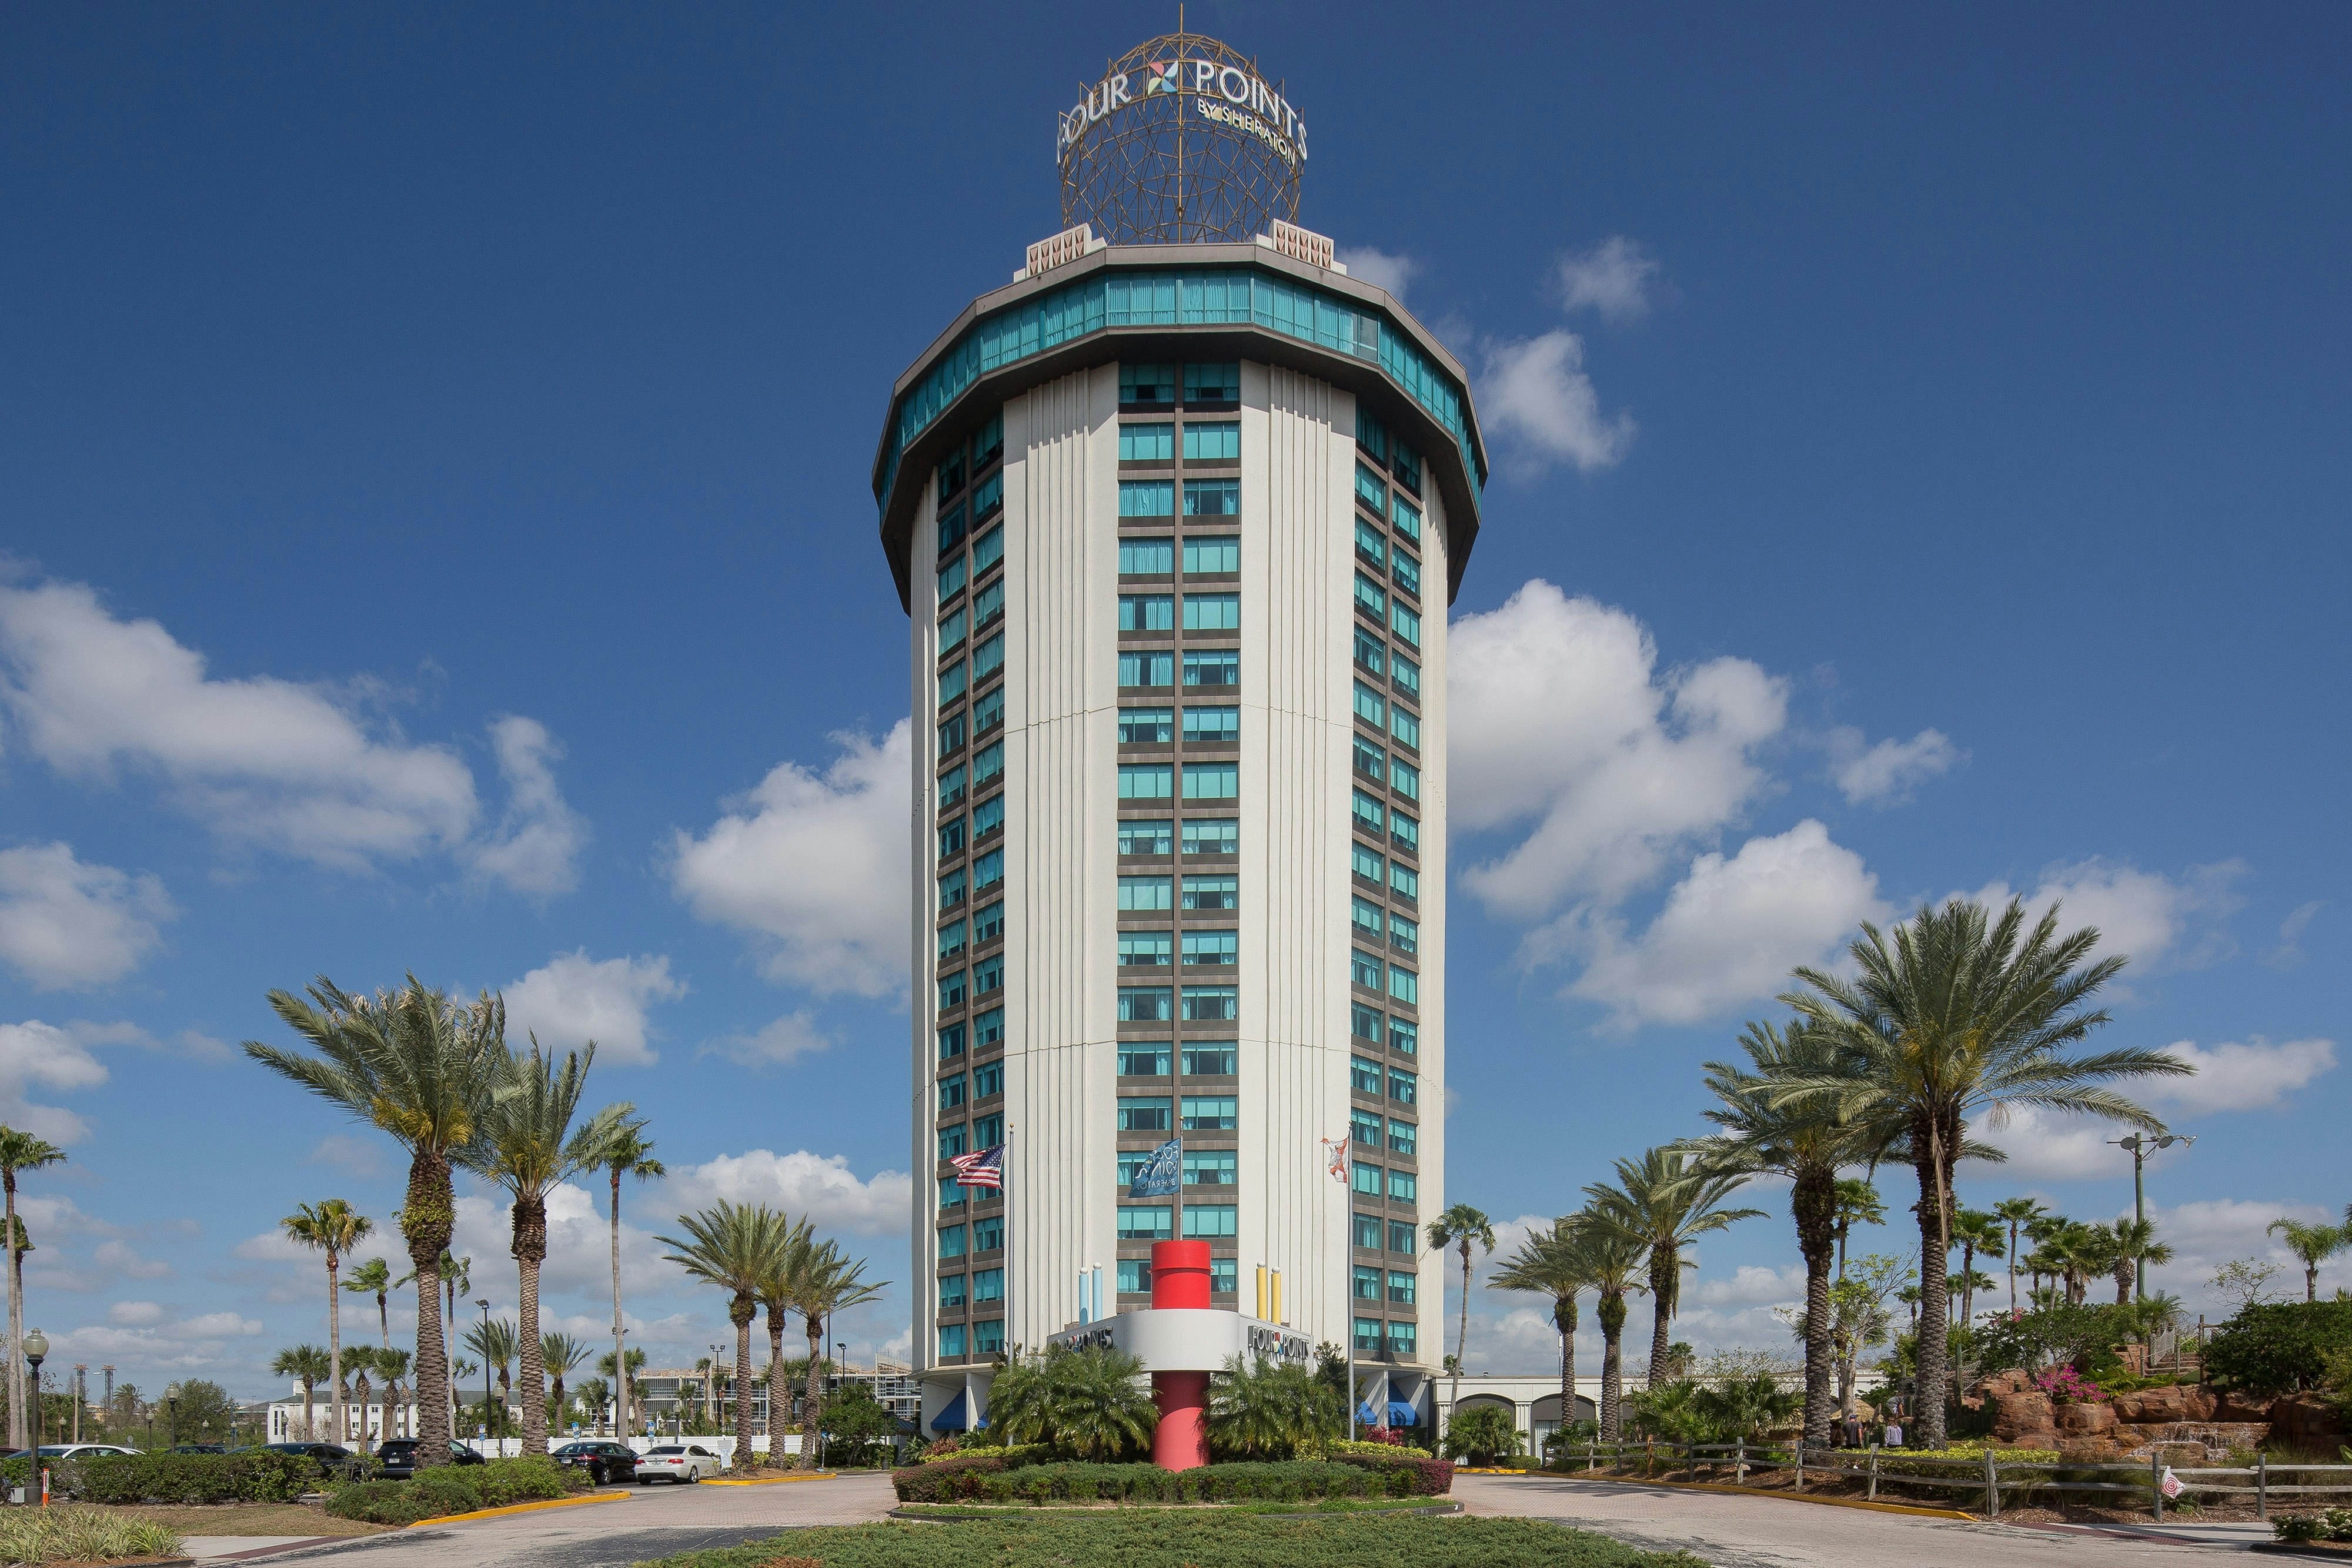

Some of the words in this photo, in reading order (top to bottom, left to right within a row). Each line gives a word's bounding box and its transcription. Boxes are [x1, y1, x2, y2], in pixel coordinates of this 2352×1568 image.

[1057, 74, 1132, 166] FOUR
[1196, 60, 1308, 160] POINTS
[1197, 98, 1217, 118] BY
[1222, 107, 1295, 166] SHERATON
[1248, 1326, 1275, 1352] FOUR
[1283, 1333, 1309, 1360] POINTS
